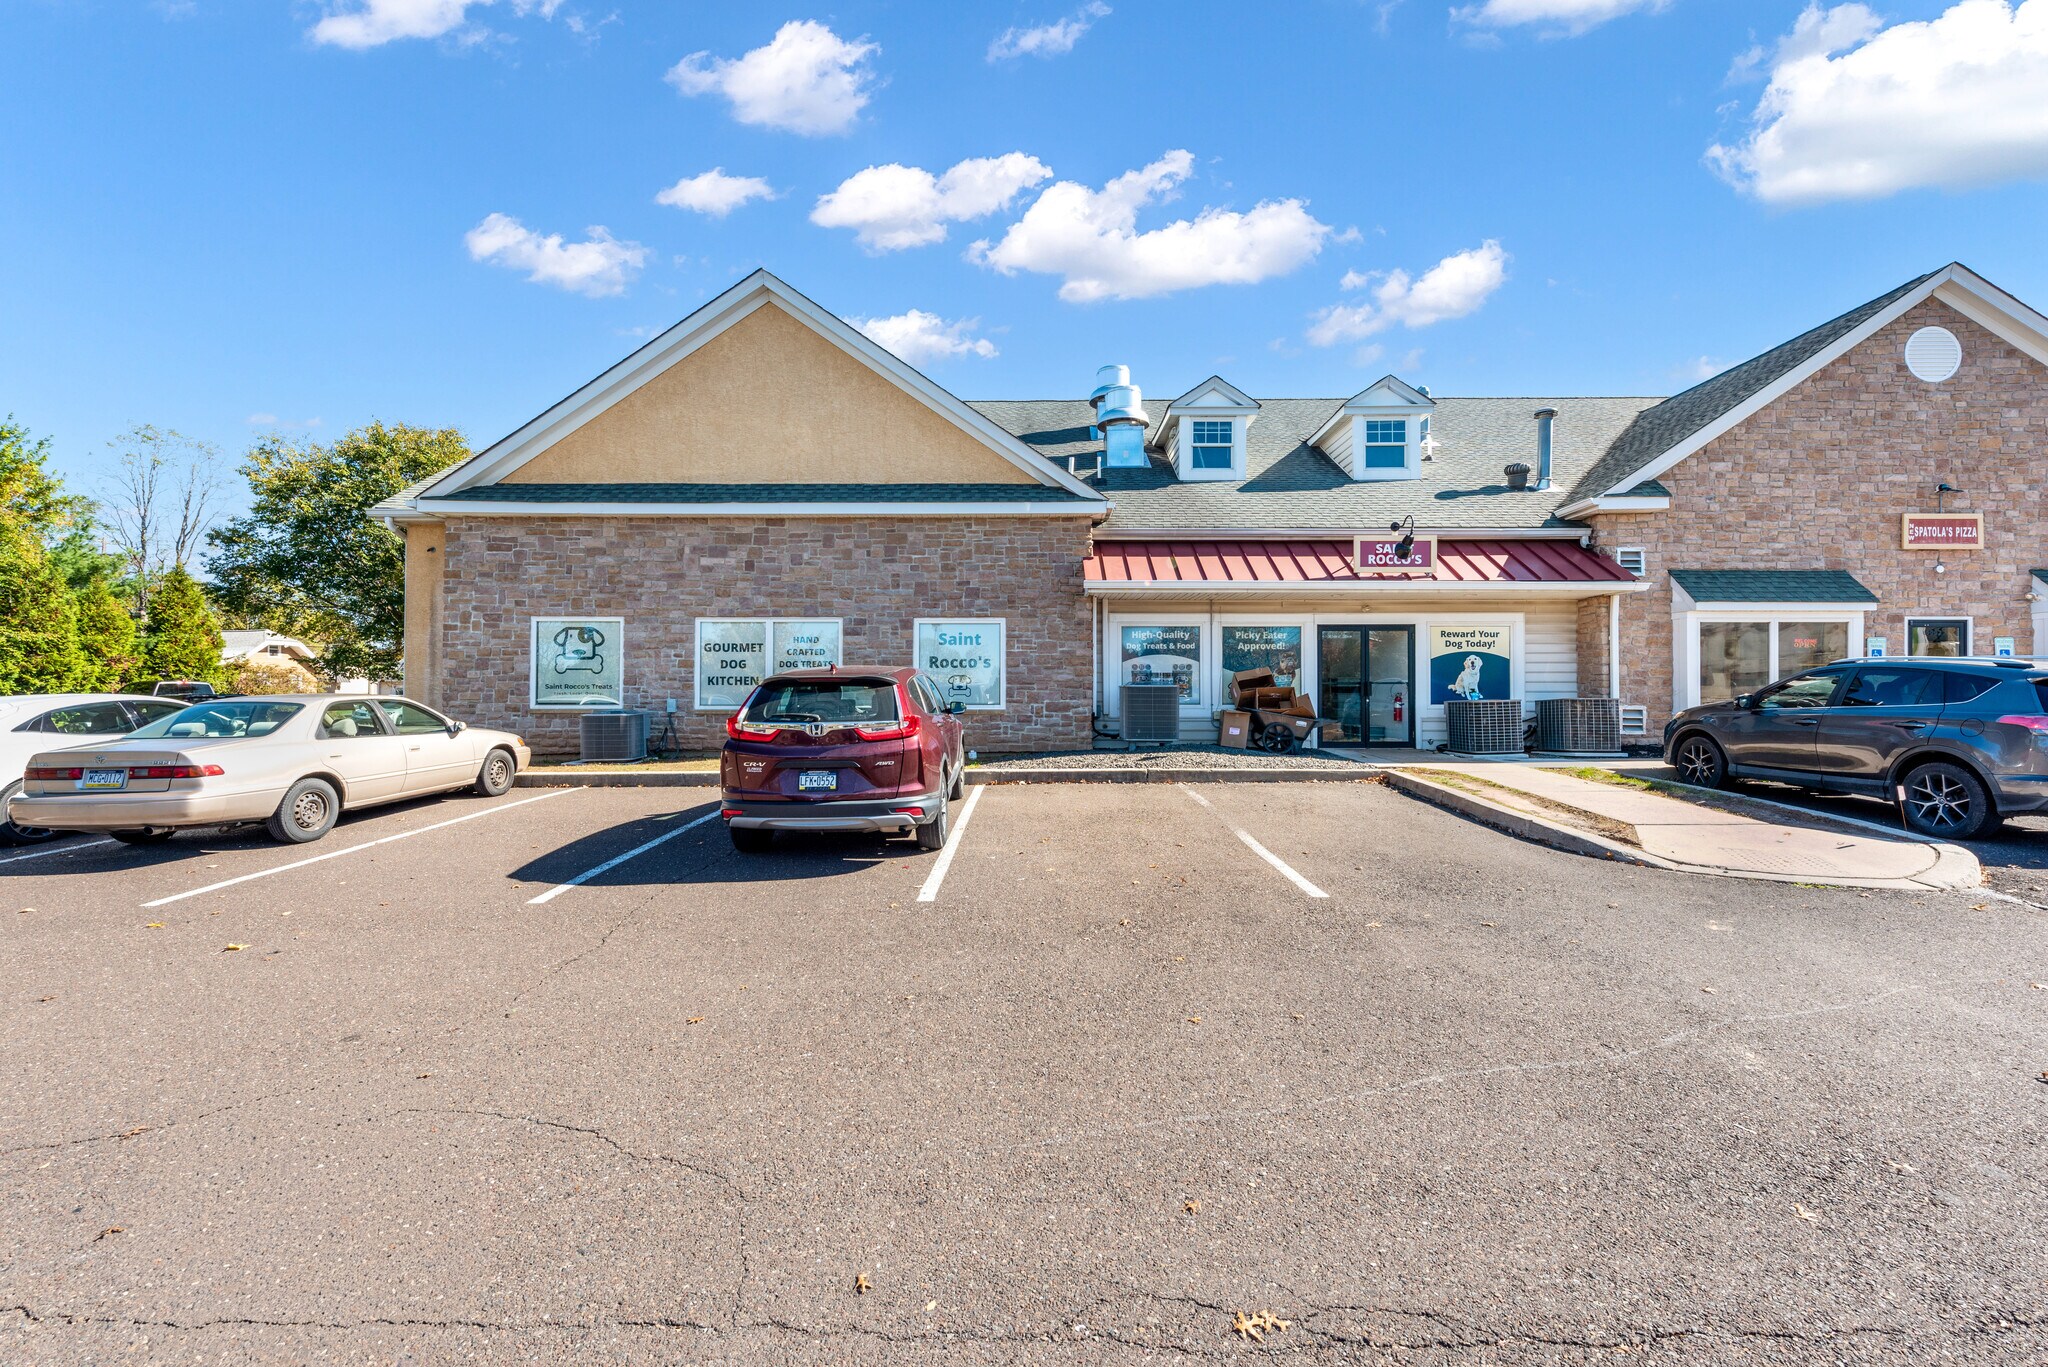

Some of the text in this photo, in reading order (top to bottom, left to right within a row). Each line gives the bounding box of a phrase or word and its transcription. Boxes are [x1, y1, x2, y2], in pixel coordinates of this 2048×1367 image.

[1914, 526, 1978, 538] SPATOLA'S PIZZA
[1375, 543, 1414, 554] SAI
[938, 632, 982, 646] Saint
[1131, 630, 1190, 641] High-Quality
[1235, 631, 1288, 641] Picky Eater
[1440, 630, 1500, 638] Reward Your
[793, 636, 820, 644] HAND
[1445, 640, 1496, 649] Dog Today!
[703, 642, 764, 653] GOURMET
[1126, 642, 1196, 651] Dog Treats & Food
[1237, 641, 1286, 652] Approved!
[786, 648, 826, 656] CRAFTED
[720, 659, 747, 669] DOG
[779, 660, 833, 668] DOG TREATS
[928, 655, 992, 669] Rocco's
[707, 676, 760, 686] KITCHEN
